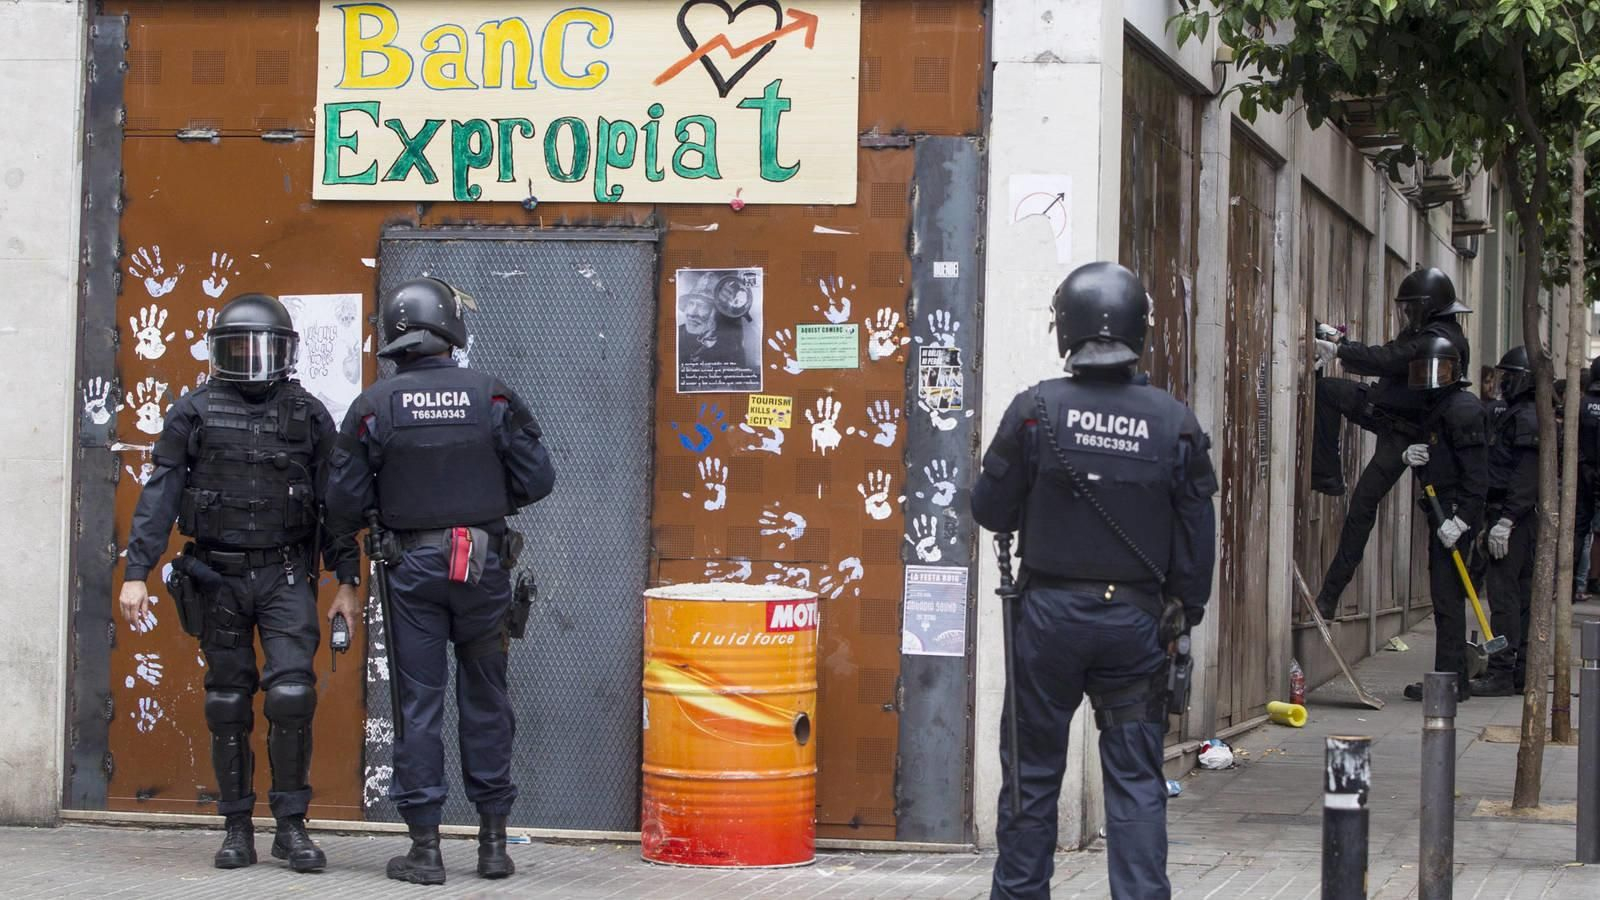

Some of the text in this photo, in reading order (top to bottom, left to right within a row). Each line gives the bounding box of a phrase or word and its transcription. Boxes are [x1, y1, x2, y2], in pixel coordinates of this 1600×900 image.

[322, 78, 800, 202] Expropiat
[402, 391, 471, 408] POLICIA
[751, 396, 791, 406] TOURISM
[411, 409, 466, 420] T663A9343
[750, 406, 771, 414] KILLS
[753, 416, 774, 425] CITY
[1066, 408, 1149, 439] POLICIA
[1074, 432, 1140, 453] T663C3934
[690, 631, 796, 646] fluid force
